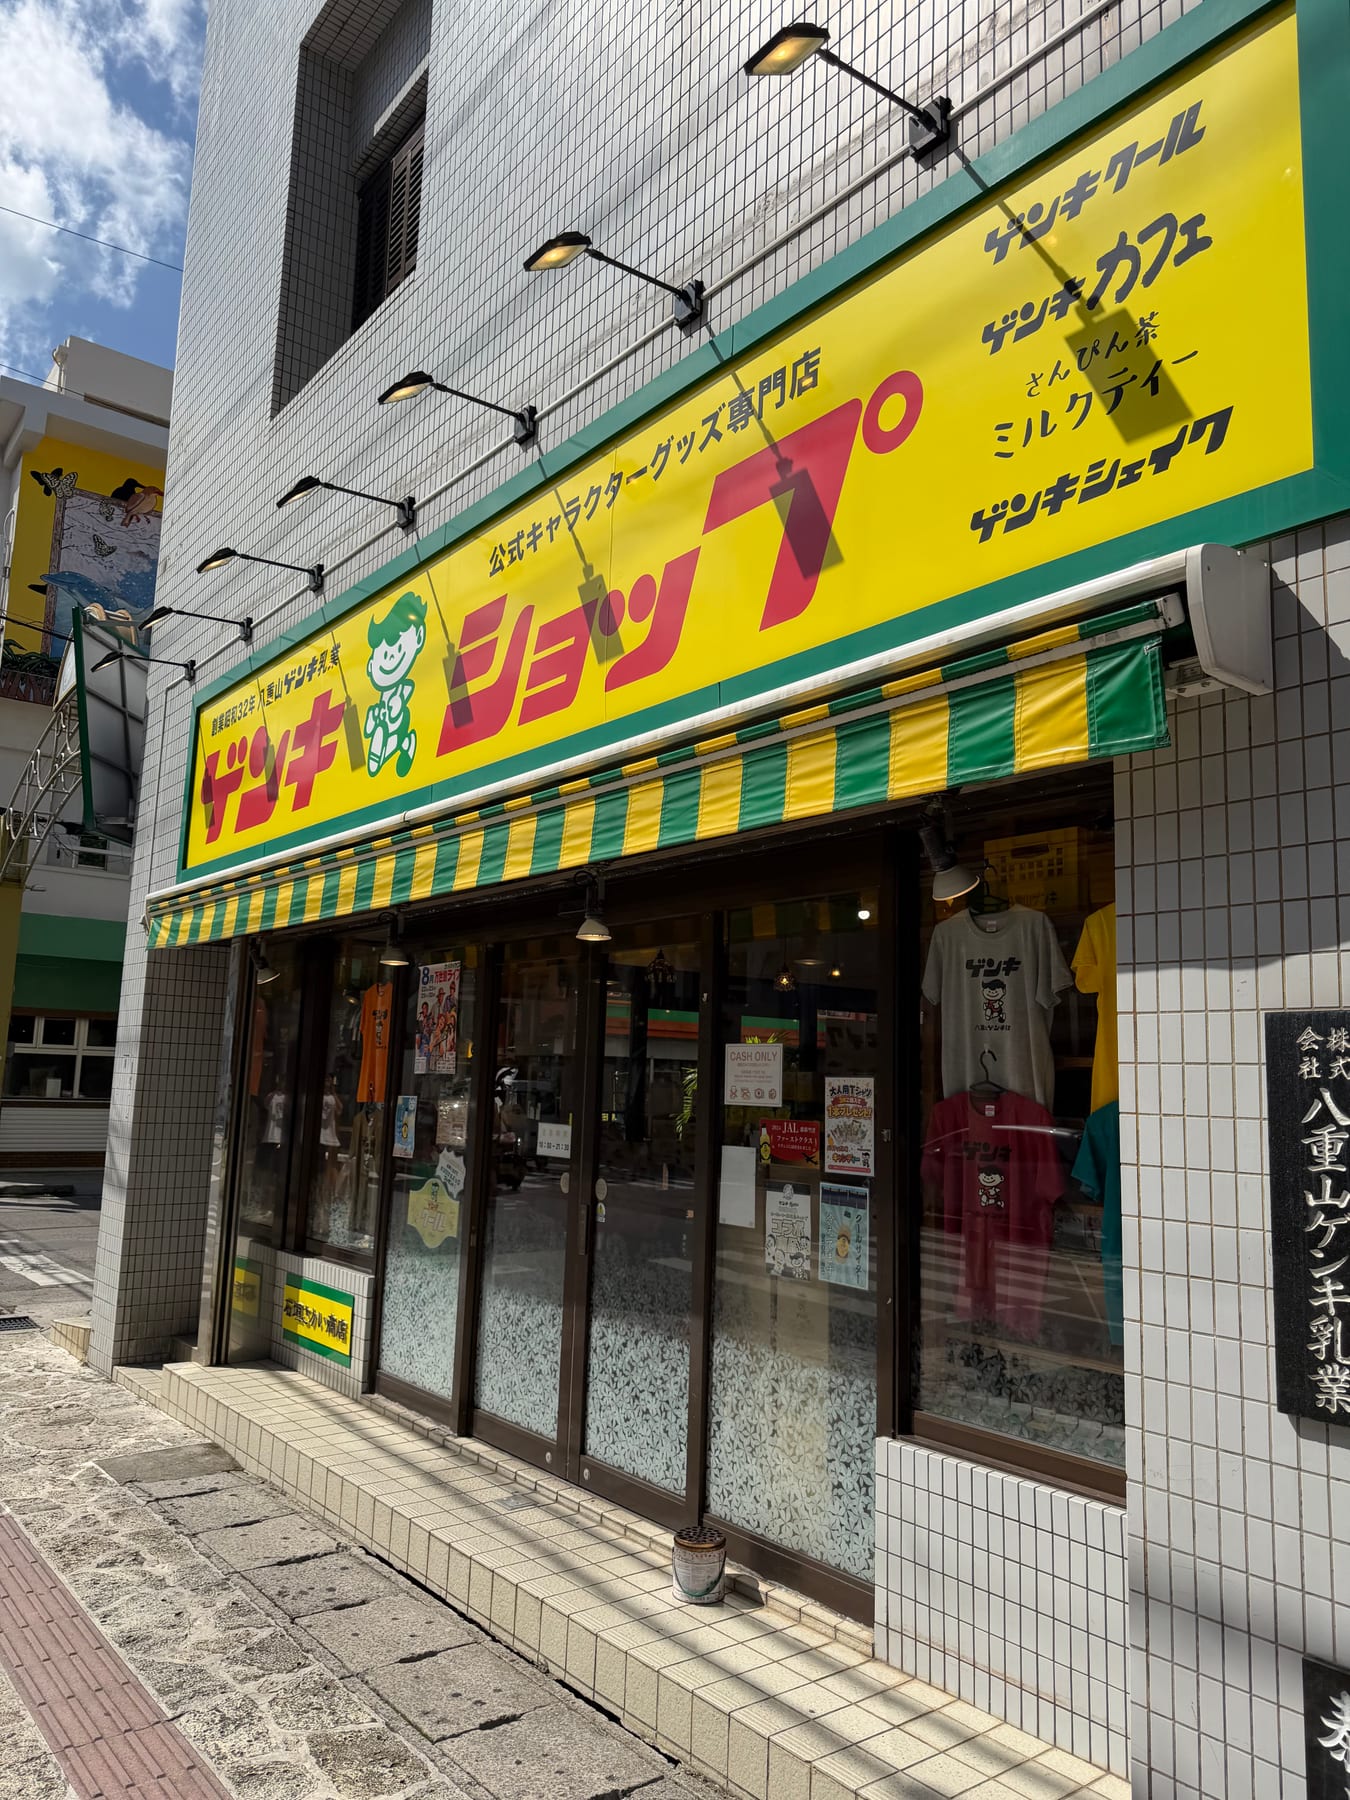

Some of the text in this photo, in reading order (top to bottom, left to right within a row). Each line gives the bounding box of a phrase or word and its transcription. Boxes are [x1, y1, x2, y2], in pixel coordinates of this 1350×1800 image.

[984, 100, 1206, 265] ゲンキクール
[981, 212, 1213, 356] ゲンキカフェ
[993, 350, 1199, 459] ミルクティー
[1025, 311, 1161, 398] さんぴん茶
[488, 346, 822, 578] 公式キャラクターグッズ専門店
[969, 405, 1235, 544] ゲンキシェイク
[200, 369, 925, 846] ゲンキ ショップ
[211, 641, 341, 736] 創業昭和32年 八重山ゲンキ乳業
[965, 956, 1022, 978] ゲンキ
[730, 1051, 778, 1062] CASH ONLY
[781, 1121, 800, 1134] JAL
[963, 1141, 1013, 1162] ゲンキ
[1300, 1087, 1350, 1415] 八重山ゲンキ乳業
